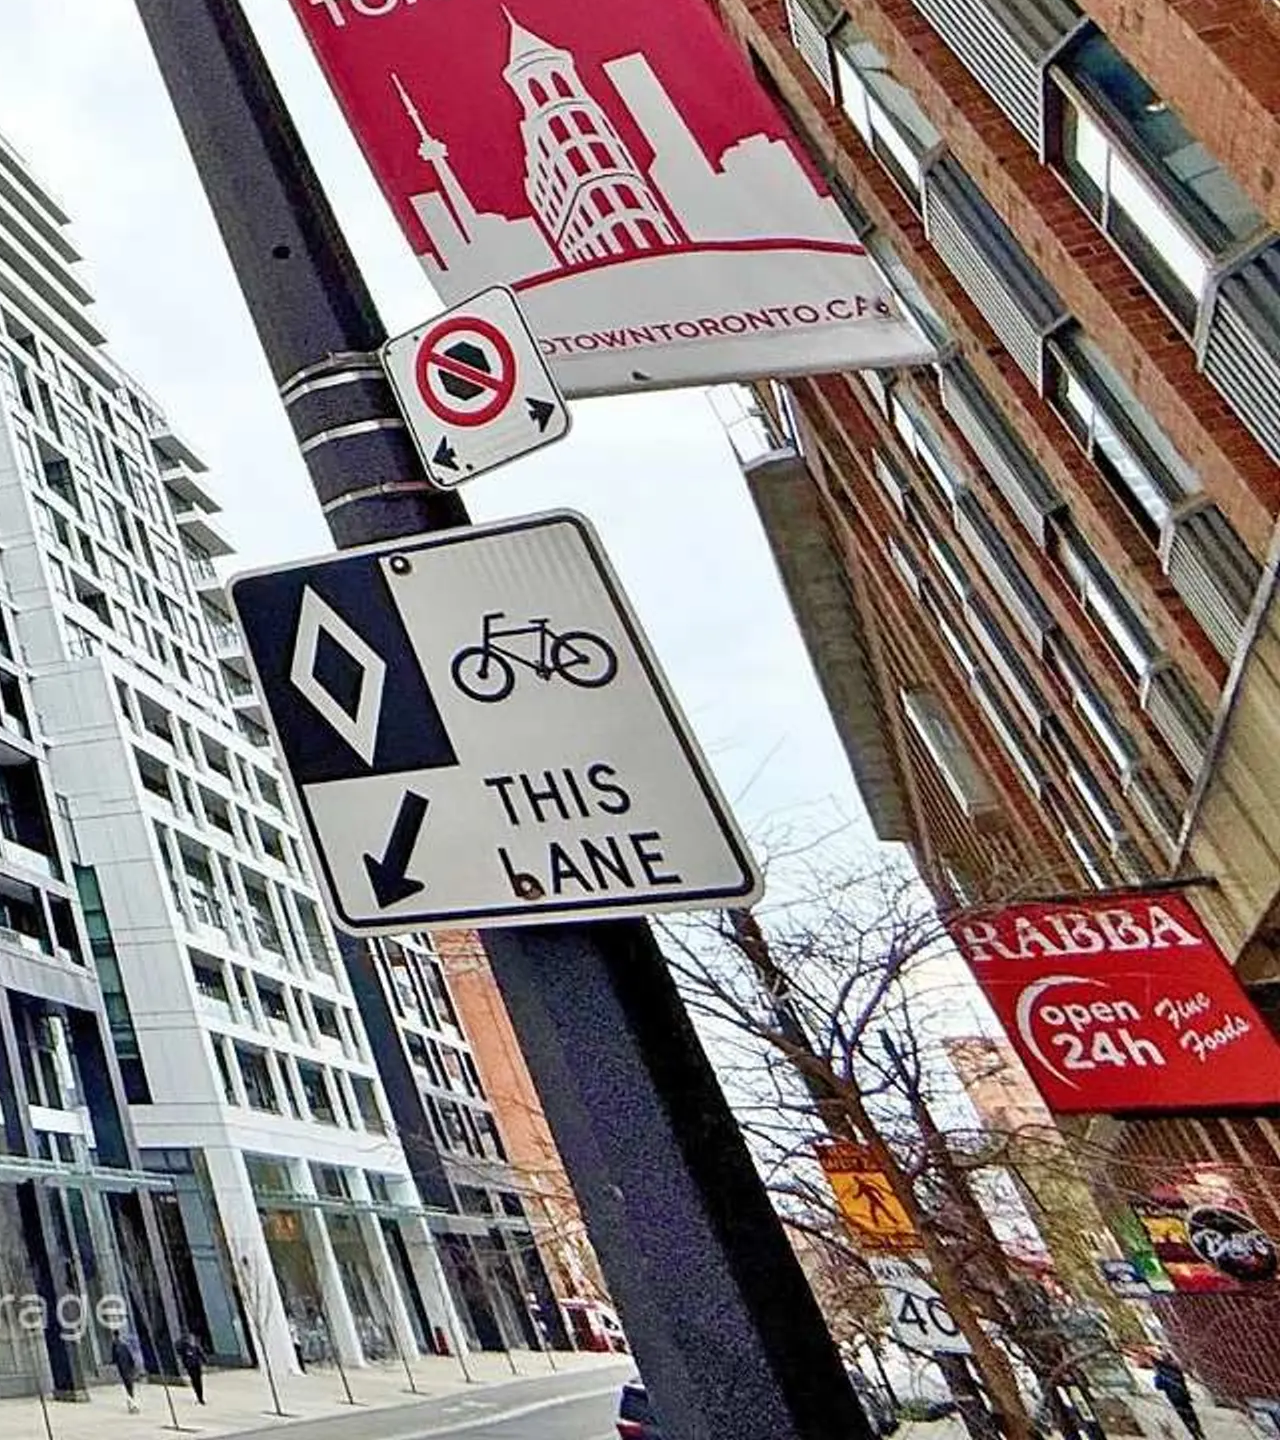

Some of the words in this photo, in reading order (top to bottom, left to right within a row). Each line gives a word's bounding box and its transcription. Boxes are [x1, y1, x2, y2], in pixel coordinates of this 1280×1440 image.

[483, 763, 631, 826] THIS
[497, 831, 683, 900] LANE
[963, 905, 1203, 961] RABBA
[1040, 999, 1142, 1033] open
[1154, 990, 1212, 1030] Fine
[1051, 1027, 1166, 1071] 24h
[1179, 1014, 1251, 1062] Foods
[898, 1292, 961, 1337] 40
